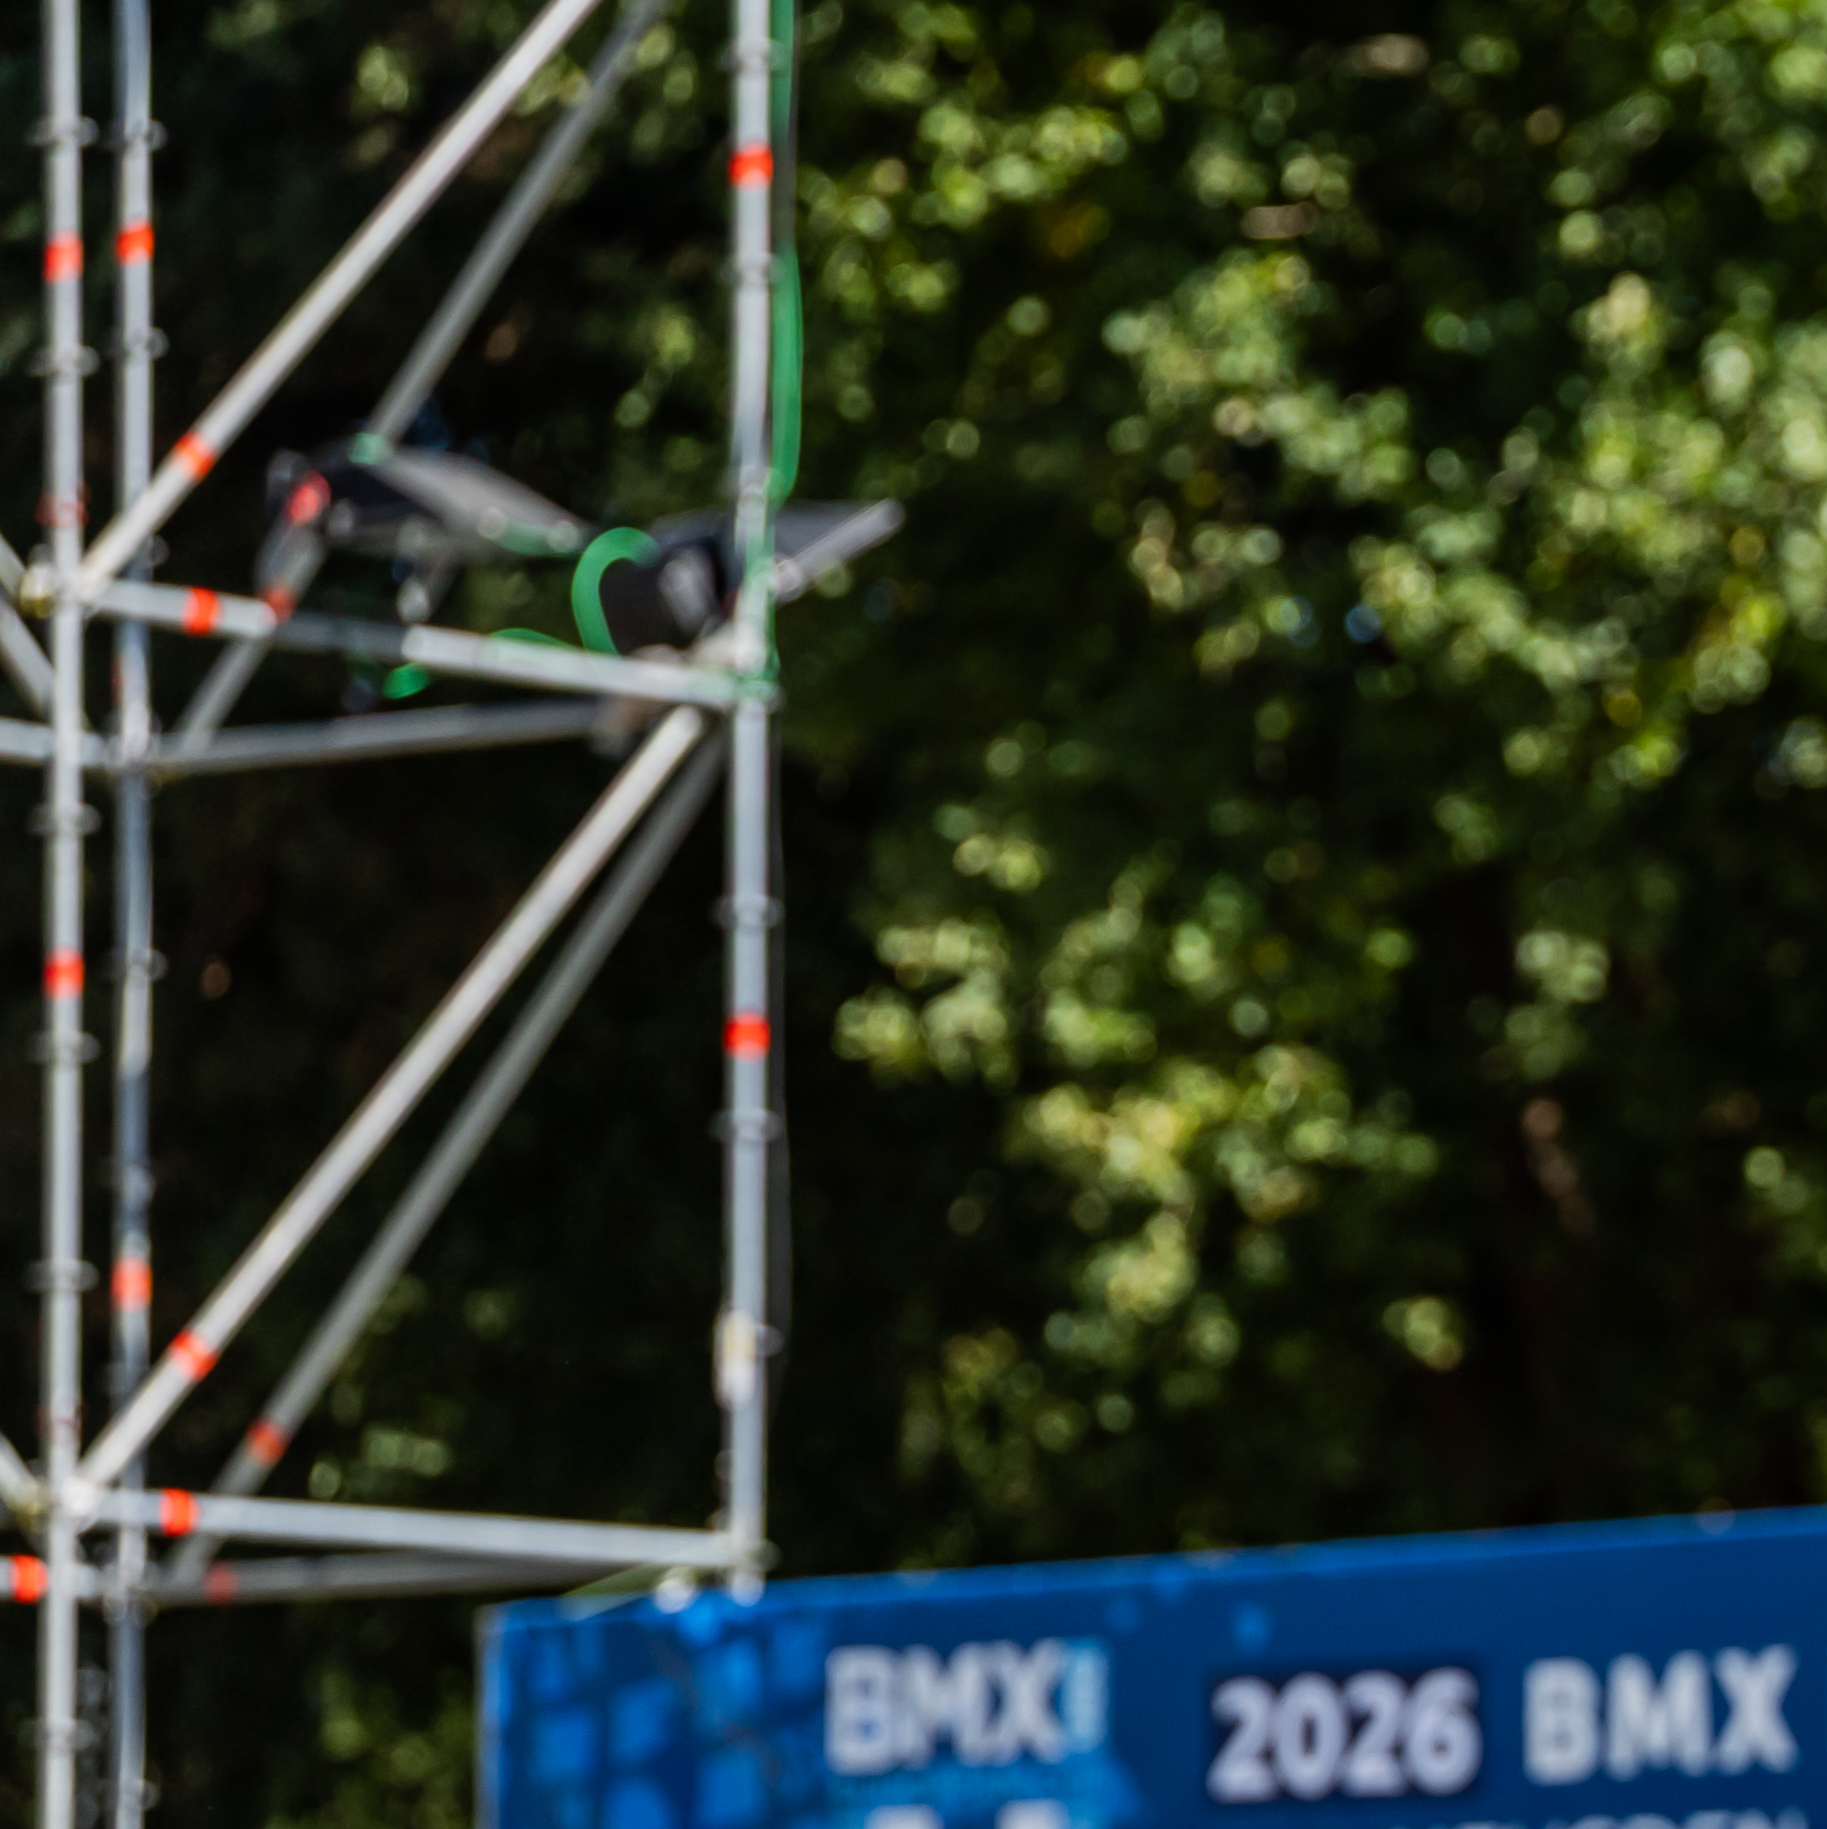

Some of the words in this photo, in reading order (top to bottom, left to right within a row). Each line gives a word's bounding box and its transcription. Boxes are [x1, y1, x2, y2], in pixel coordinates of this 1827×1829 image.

[823, 1640, 1068, 1776] BMX
[1206, 1667, 1483, 1799] 2026
[1522, 1652, 1797, 1788] BMX
